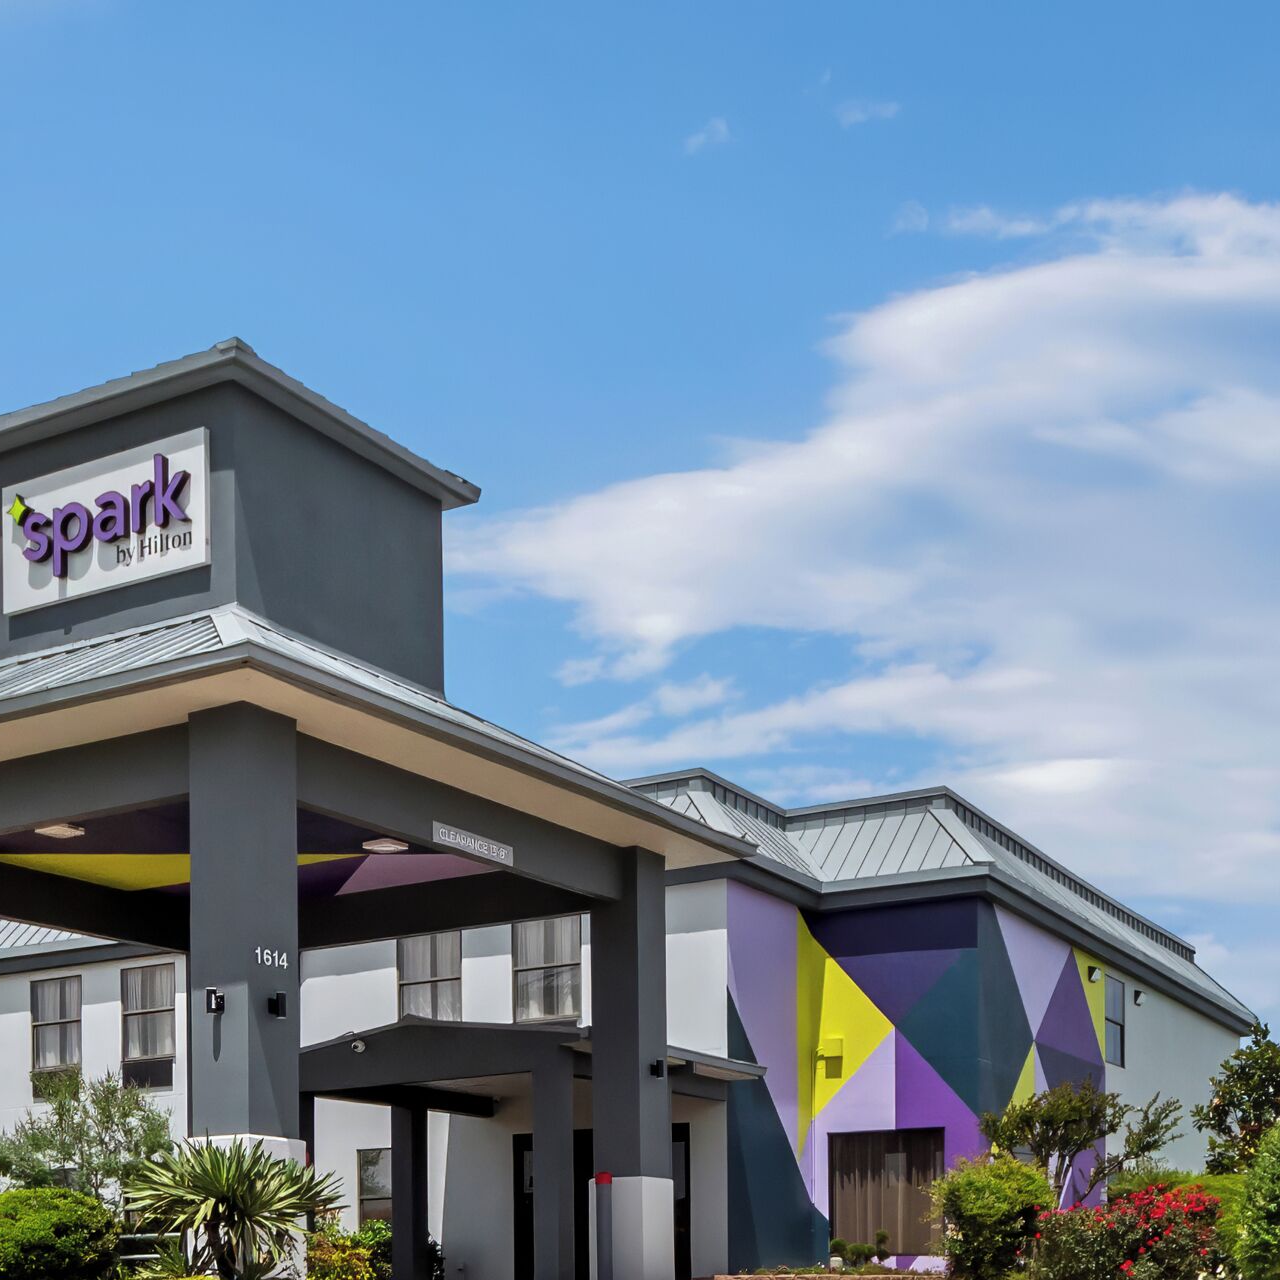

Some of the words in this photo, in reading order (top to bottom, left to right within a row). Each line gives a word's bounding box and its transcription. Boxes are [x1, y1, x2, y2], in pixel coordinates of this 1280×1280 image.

[22, 453, 192, 578] spark
[116, 545, 136, 566] by
[139, 530, 193, 558] Hilton
[254, 946, 289, 969] 1614
